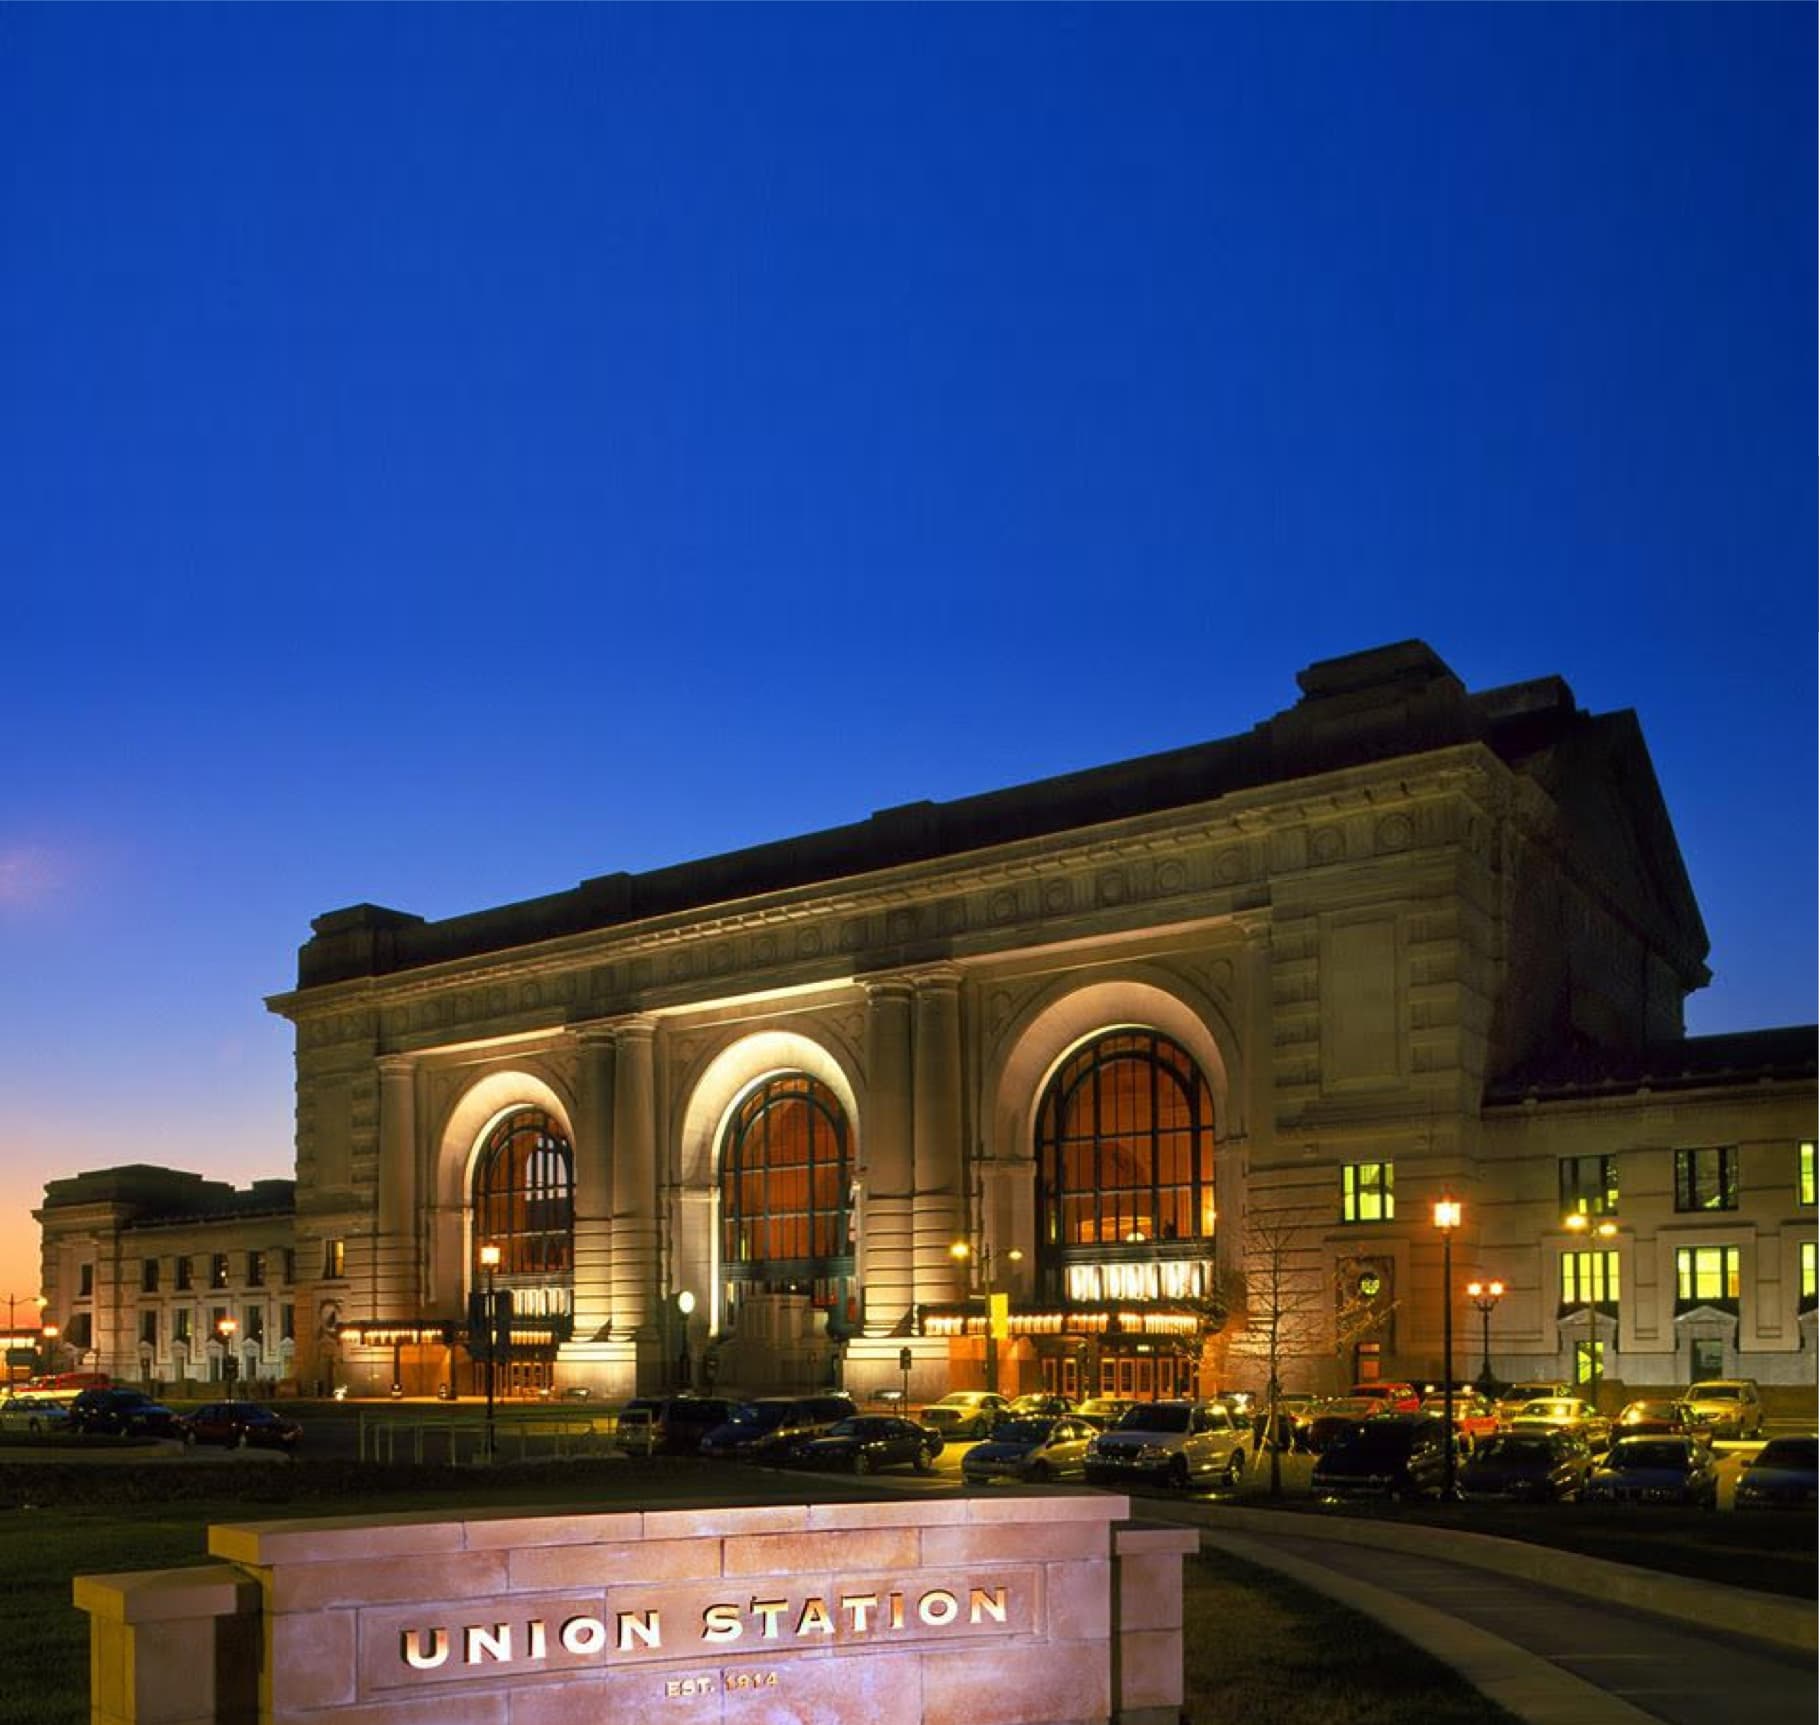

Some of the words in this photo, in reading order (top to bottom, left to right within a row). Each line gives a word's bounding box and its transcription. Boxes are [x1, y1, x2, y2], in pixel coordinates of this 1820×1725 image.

[400, 1611, 661, 1668] UNION
[702, 1587, 1008, 1641] STATION
[666, 1677, 715, 1697] EST.
[725, 1671, 779, 1691] 1914
